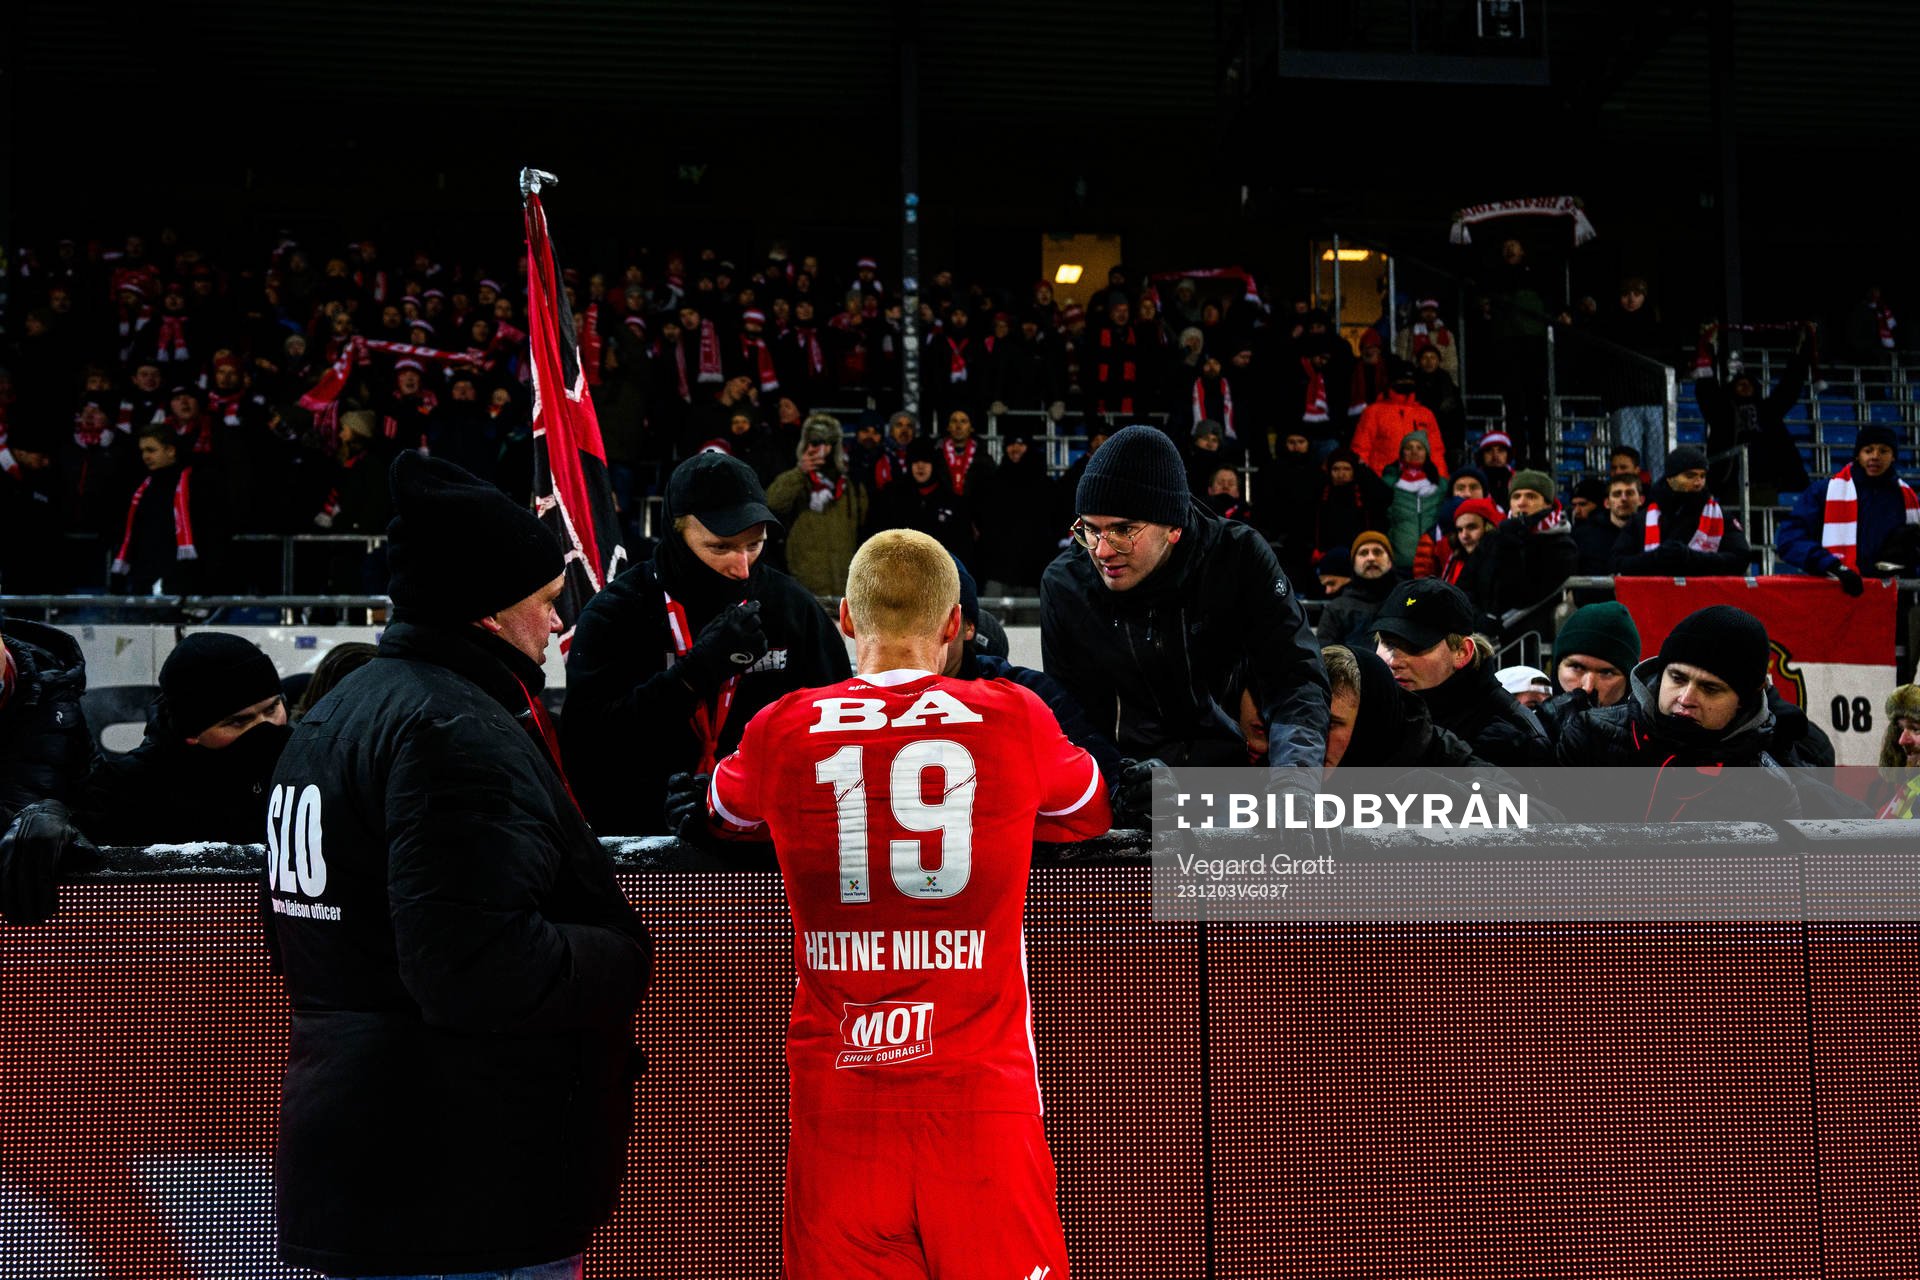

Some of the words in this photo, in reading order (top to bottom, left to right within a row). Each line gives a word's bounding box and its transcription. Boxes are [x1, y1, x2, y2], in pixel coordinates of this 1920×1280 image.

[809, 690, 983, 734] BA
[1831, 695, 1872, 732] 08
[267, 784, 327, 898] SLO
[815, 739, 976, 903] 19
[285, 899, 311, 918] liaison
[311, 903, 341, 921] officer
[804, 931, 885, 971] HELTNE
[893, 930, 986, 970] NILSEN
[852, 1003, 934, 1047] MOT
[842, 1054, 873, 1063] SHOW
[876, 1043, 925, 1062] COURAGE!
